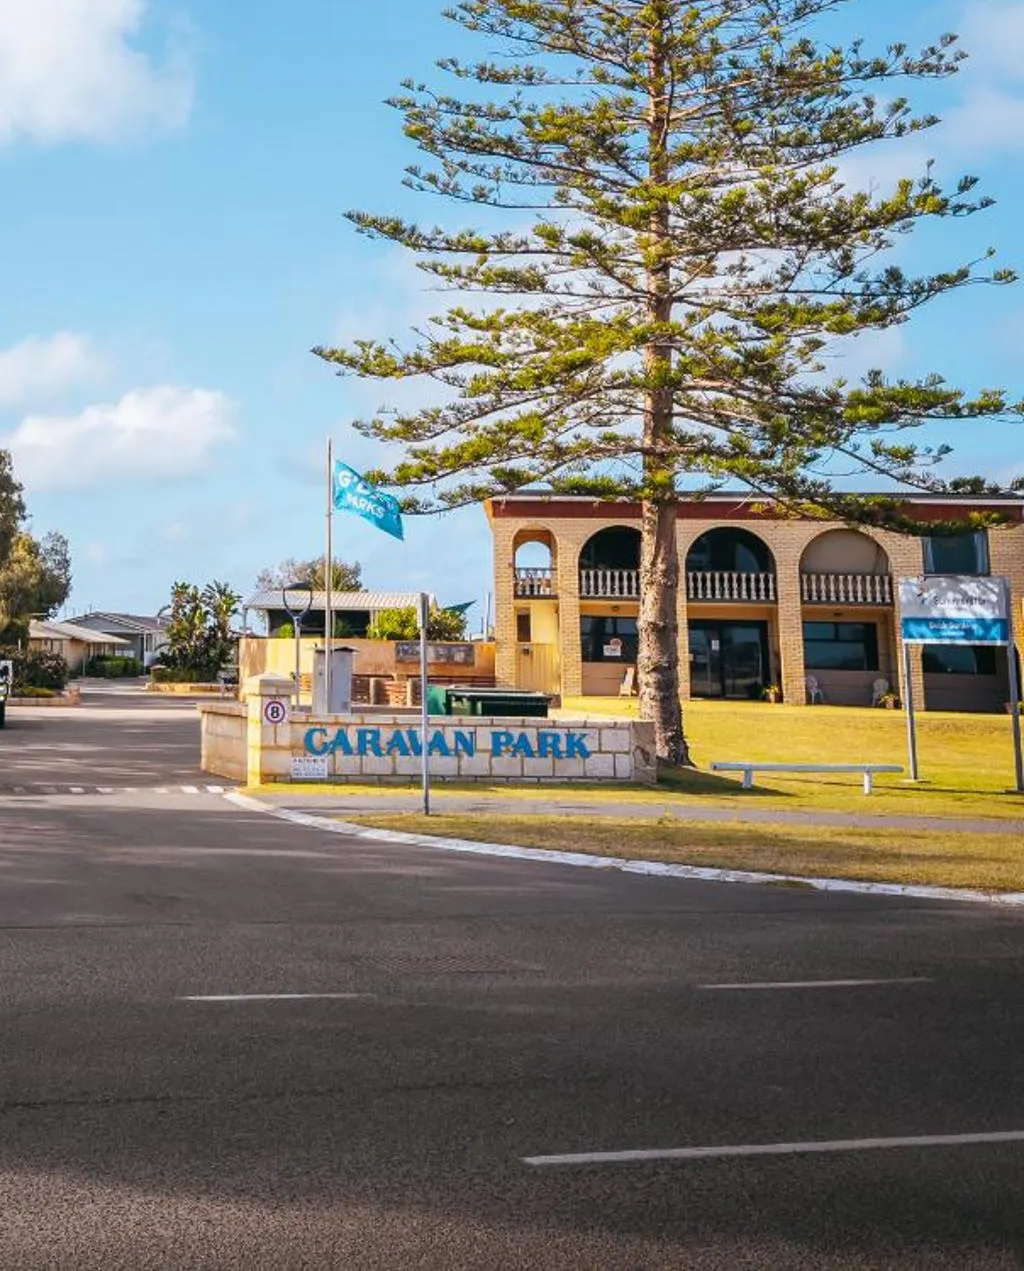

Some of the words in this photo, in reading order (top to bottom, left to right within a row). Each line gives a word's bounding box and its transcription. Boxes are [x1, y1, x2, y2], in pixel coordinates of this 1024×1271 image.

[270, 705, 280, 719] 8
[303, 727, 475, 758] CARAVAN
[491, 731, 592, 760] PARK
